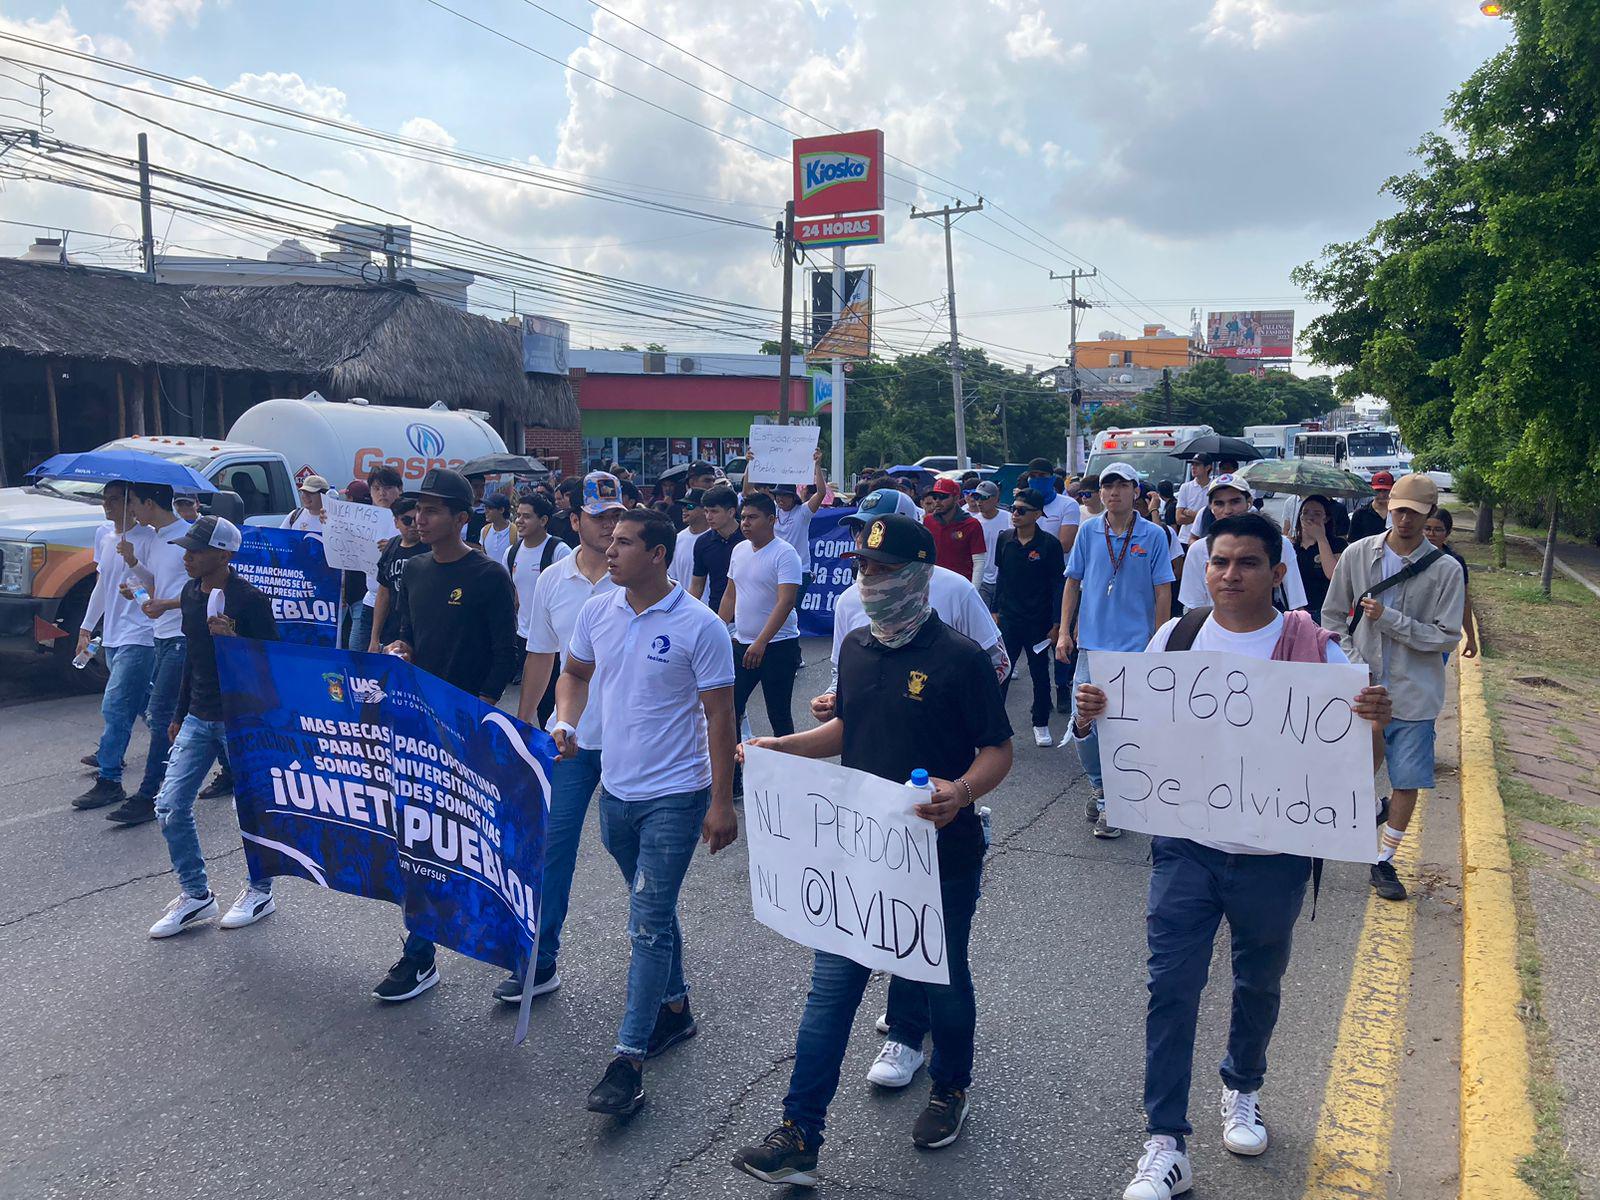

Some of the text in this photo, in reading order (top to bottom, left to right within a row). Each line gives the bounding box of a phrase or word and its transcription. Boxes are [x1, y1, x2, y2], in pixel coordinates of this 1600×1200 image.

[806, 157, 865, 189] Kiosko
[802, 220, 871, 238] 24 HORAS
[353, 447, 466, 480] Gasp
[237, 564, 254, 574] PAZ
[255, 567, 305, 580] MARCHAMOS,
[832, 566, 855, 585] so
[255, 585, 315, 598] STA PRESENTE
[801, 591, 821, 611] en
[269, 598, 337, 622] EBLO!
[349, 677, 381, 693] UAS
[1107, 665, 1353, 744] 1968 NO
[300, 716, 501, 802] MAS BECAS PAGO OPORTUNO
[318, 738, 365, 759] PARA
[365, 744, 392, 765] LOS
[391, 756, 495, 819] NIVERSITARIOS
[1113, 742, 1358, 829] Se olvida!
[313, 755, 501, 848] SOMOS GRDES SOMOS UAS
[755, 790, 931, 875] NI PERDON
[404, 804, 537, 934] PUEBLO!
[412, 863, 447, 882] Versus
[757, 864, 944, 967] NI OLVIDO
